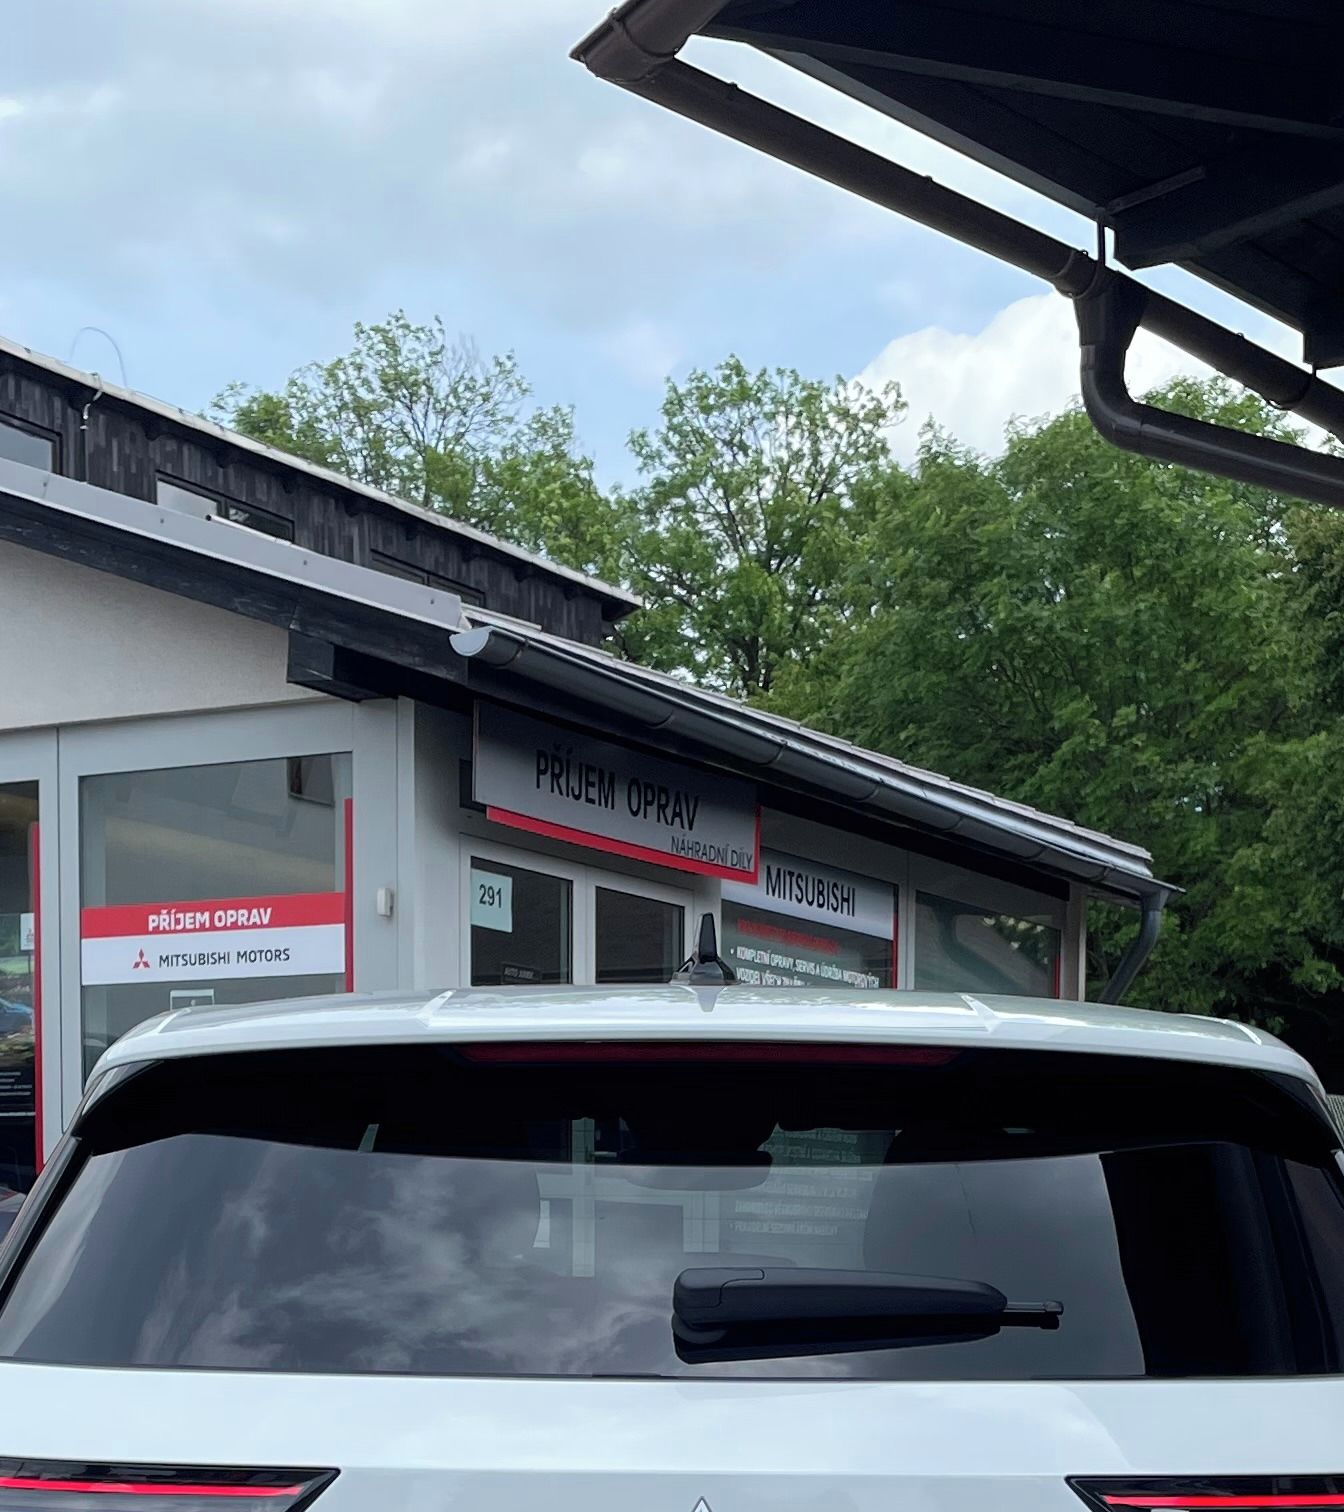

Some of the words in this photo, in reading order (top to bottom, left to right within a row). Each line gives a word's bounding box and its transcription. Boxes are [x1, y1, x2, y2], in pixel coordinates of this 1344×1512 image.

[536, 740, 616, 811] PŘÍJEM
[626, 776, 702, 832] OPRAV
[669, 832, 729, 868] NÁHRADNÍ
[730, 845, 754, 872] DÍLY
[479, 883, 502, 909] 291
[765, 864, 857, 918] MITSUBISHI
[147, 908, 210, 932] PŘÍJEM
[214, 907, 272, 928] OPRAV
[158, 951, 231, 968] MITSUBISHI
[236, 947, 291, 965] MOTORS
